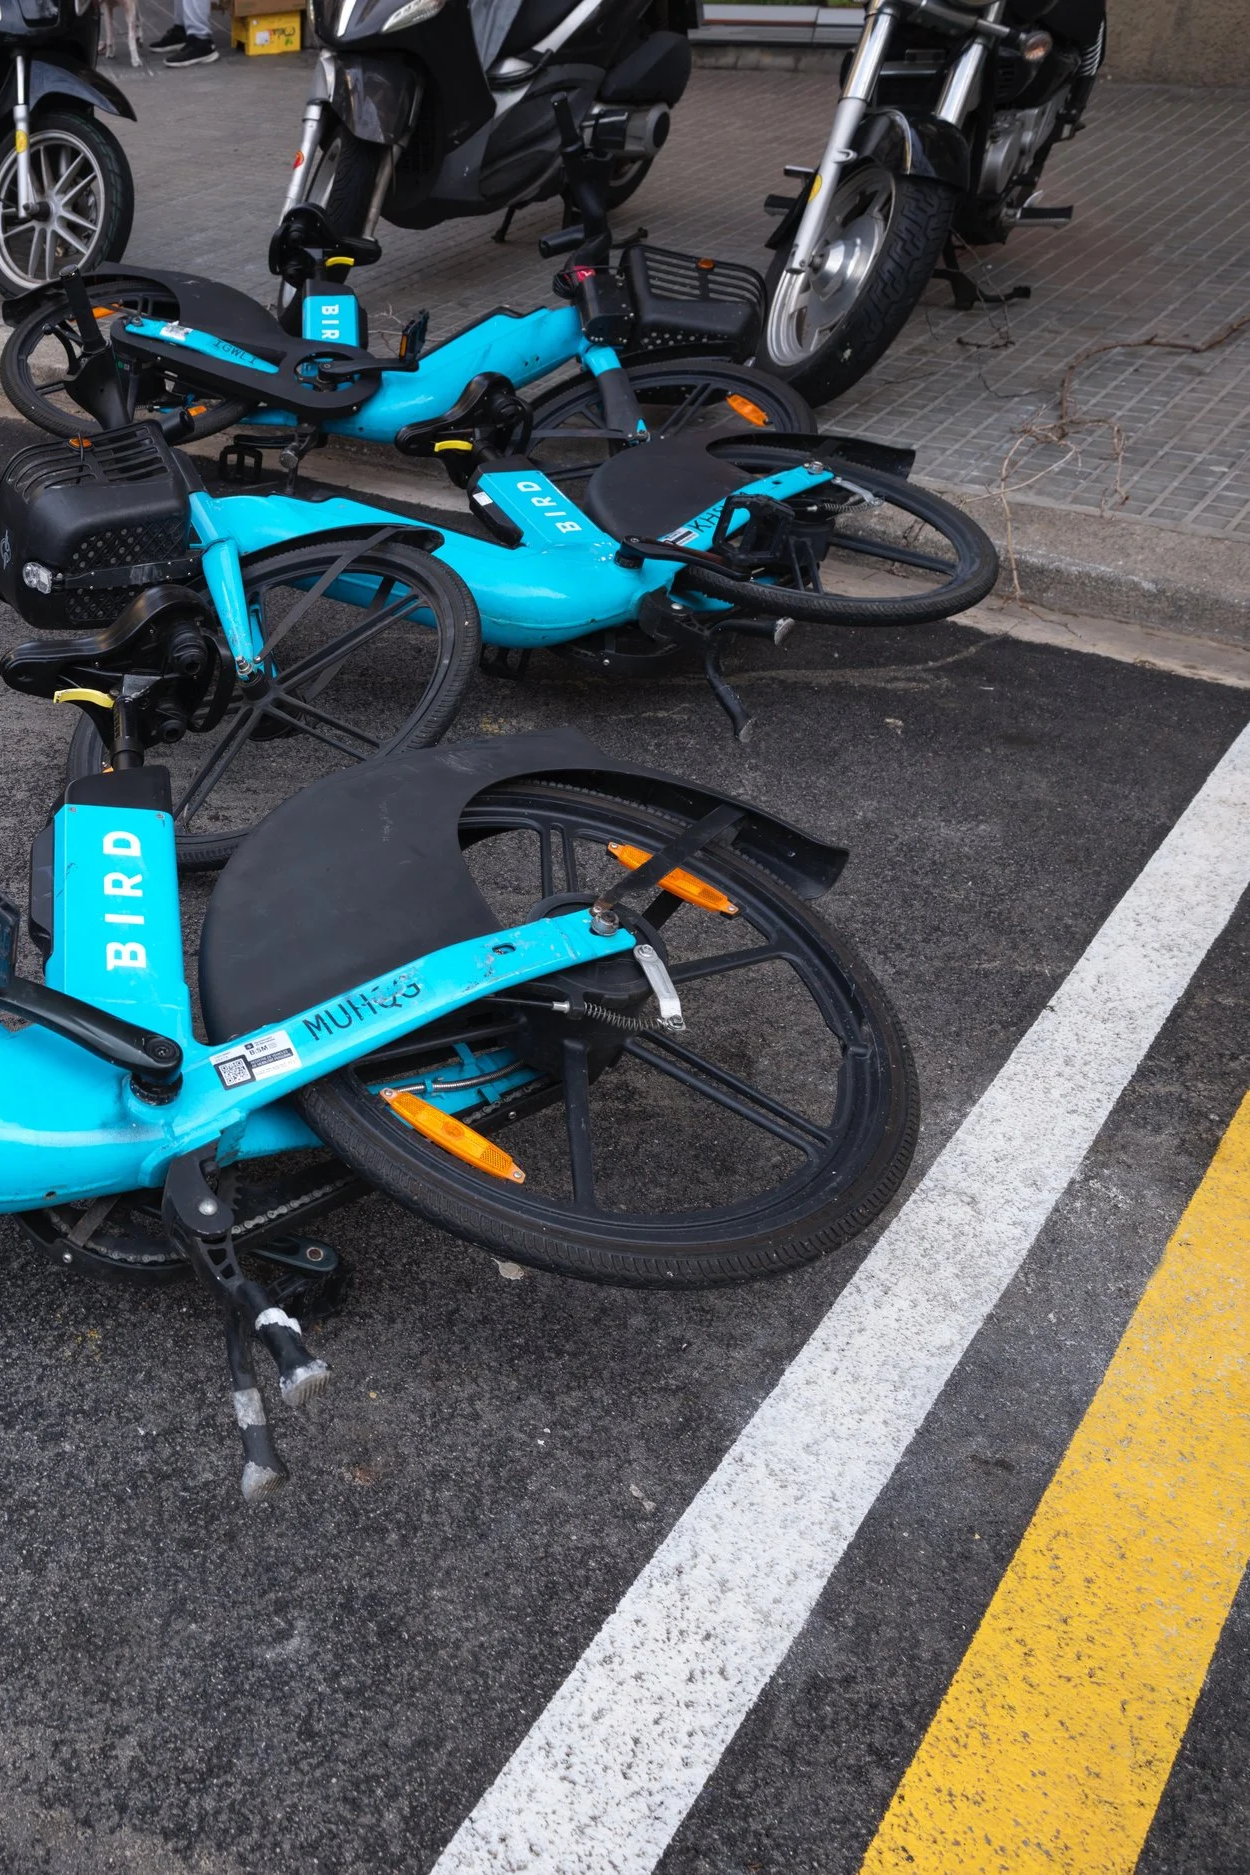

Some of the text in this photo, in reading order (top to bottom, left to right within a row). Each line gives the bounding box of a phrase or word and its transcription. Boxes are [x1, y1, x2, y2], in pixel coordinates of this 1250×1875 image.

[321, 304, 340, 339] BIR
[516, 481, 582, 534] BIRD
[102, 830, 147, 971] BIRD
